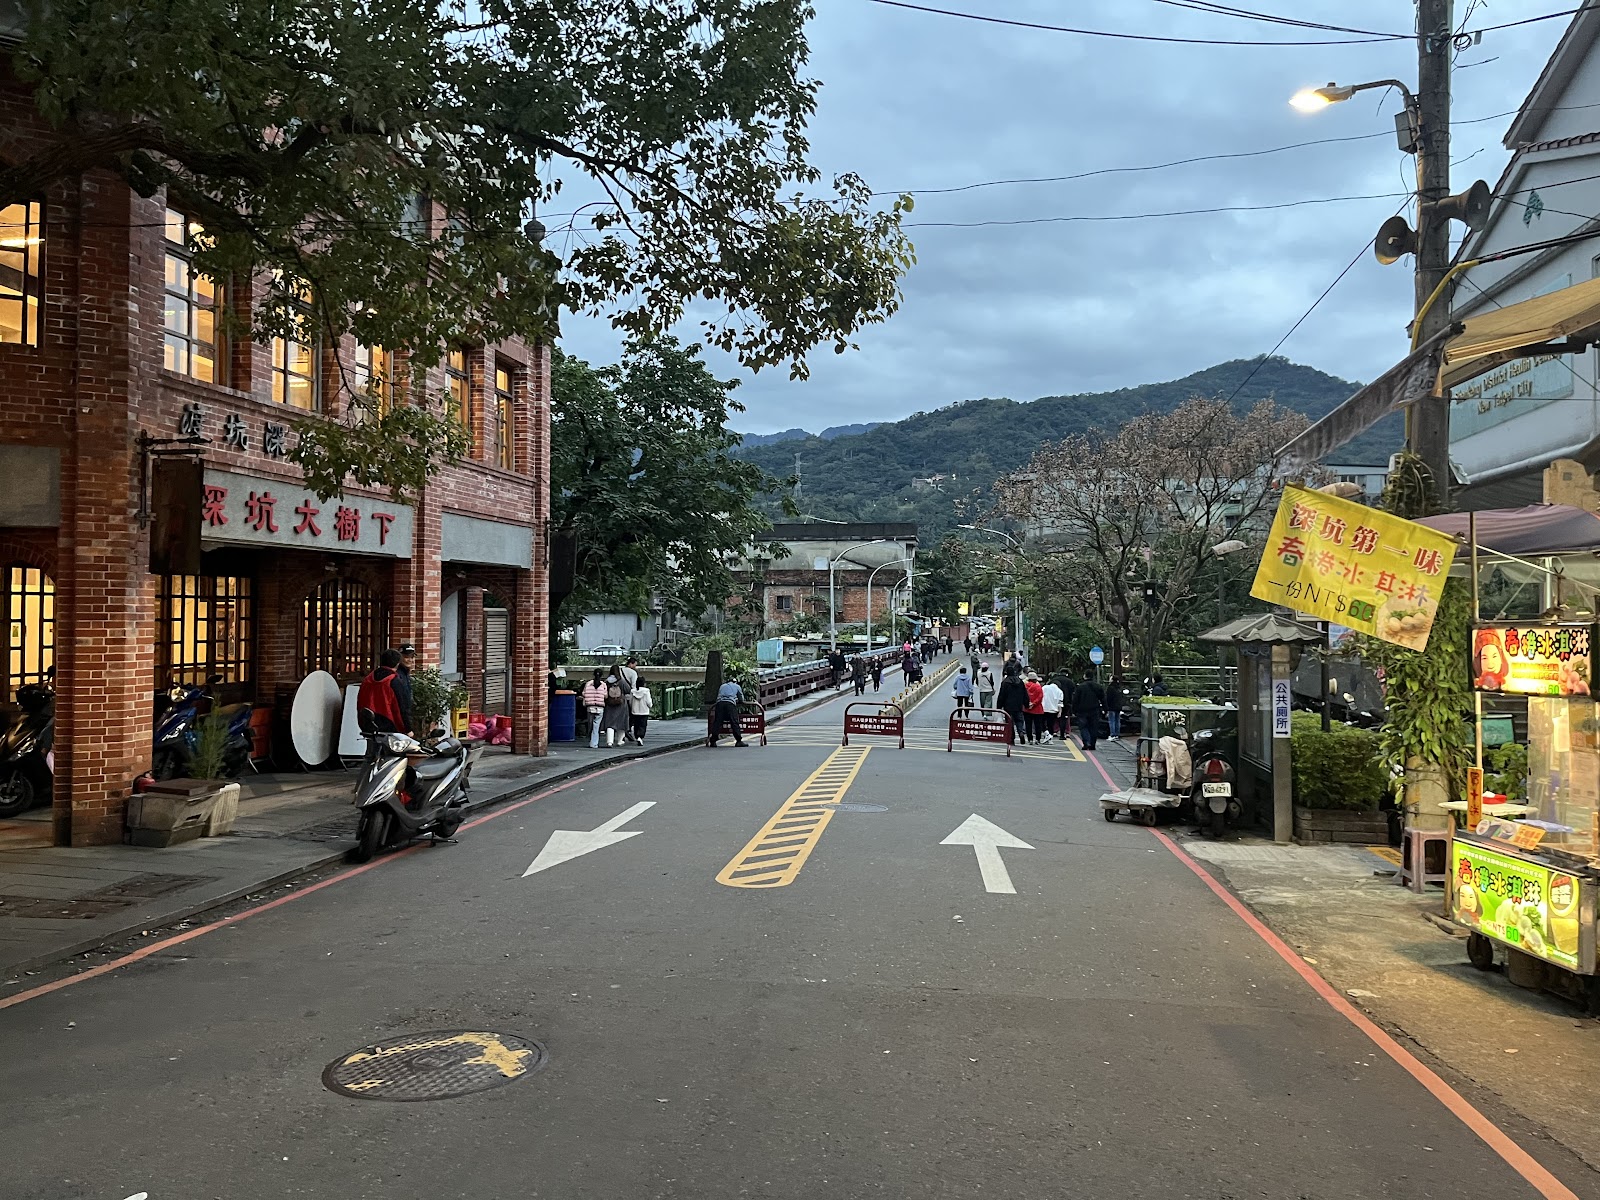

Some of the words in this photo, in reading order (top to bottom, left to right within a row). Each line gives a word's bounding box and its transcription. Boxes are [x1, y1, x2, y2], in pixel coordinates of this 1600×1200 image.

[1510, 357, 1532, 378] Health
[1478, 400, 1491, 415] New
[1518, 380, 1533, 397] City
[1289, 502, 1443, 577] 深坑第一味
[1505, 627, 1590, 662] 春捲冰淇淋
[1275, 682, 1288, 729] 公共廁所
[1459, 857, 1541, 907] 春捲冰淇淋
